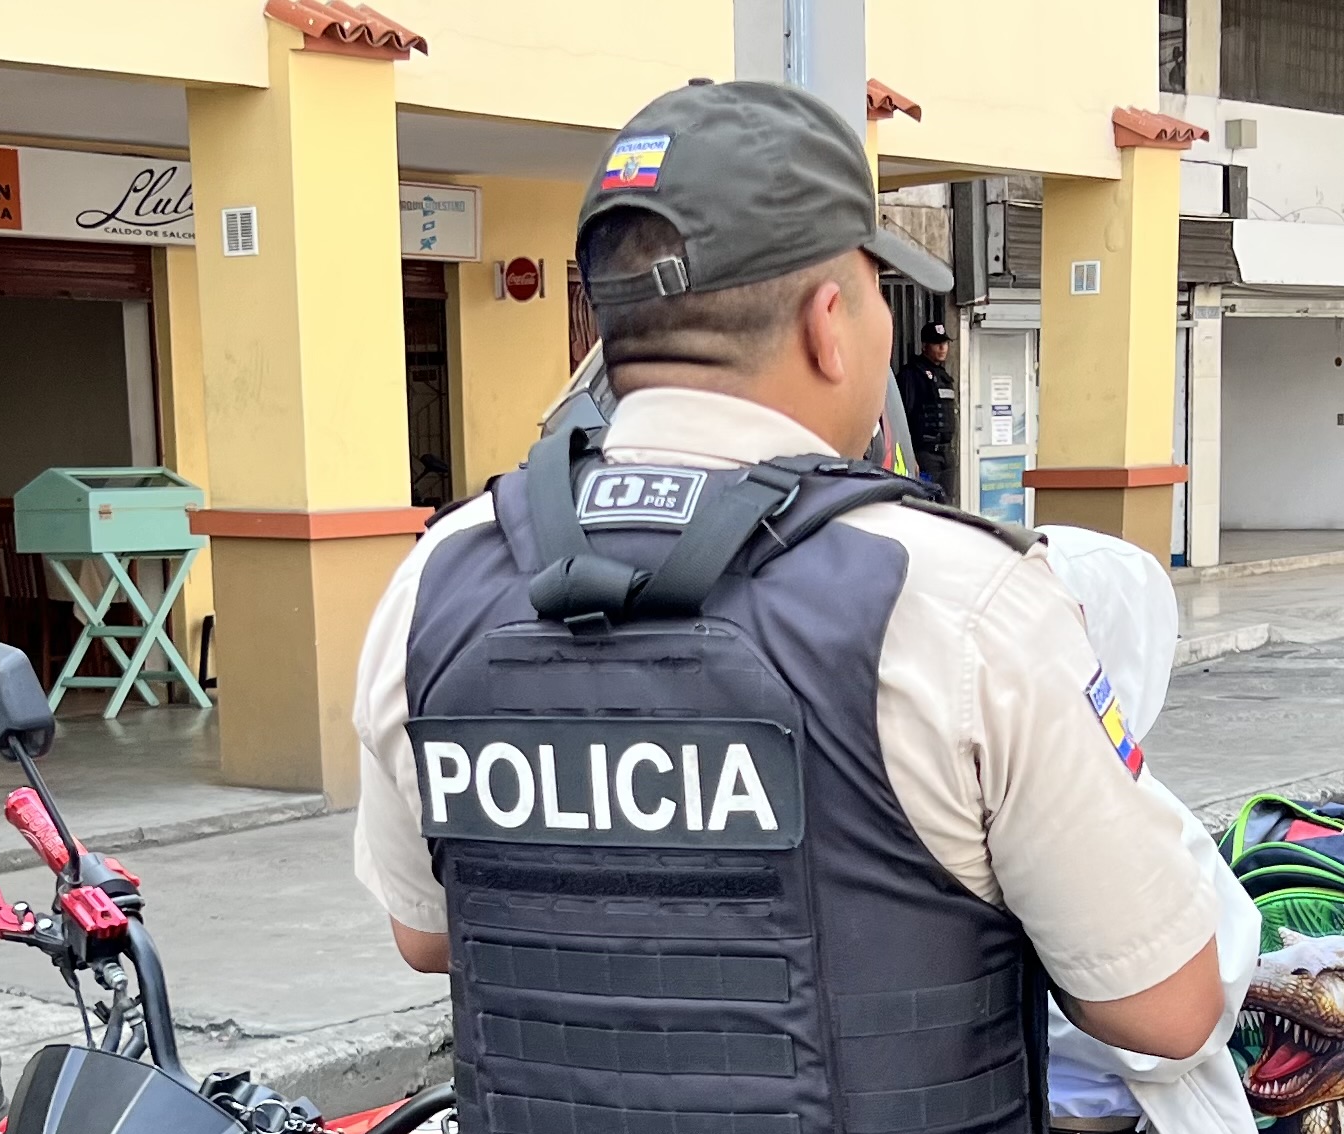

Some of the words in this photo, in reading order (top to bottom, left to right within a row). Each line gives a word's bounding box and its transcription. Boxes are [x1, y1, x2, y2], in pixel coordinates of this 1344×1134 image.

[616, 141, 665, 153] ECUADOR
[104, 226, 142, 236] CALDO
[162, 231, 195, 239] SALCH
[643, 495, 677, 508] POS
[423, 741, 779, 831] POLICIA
